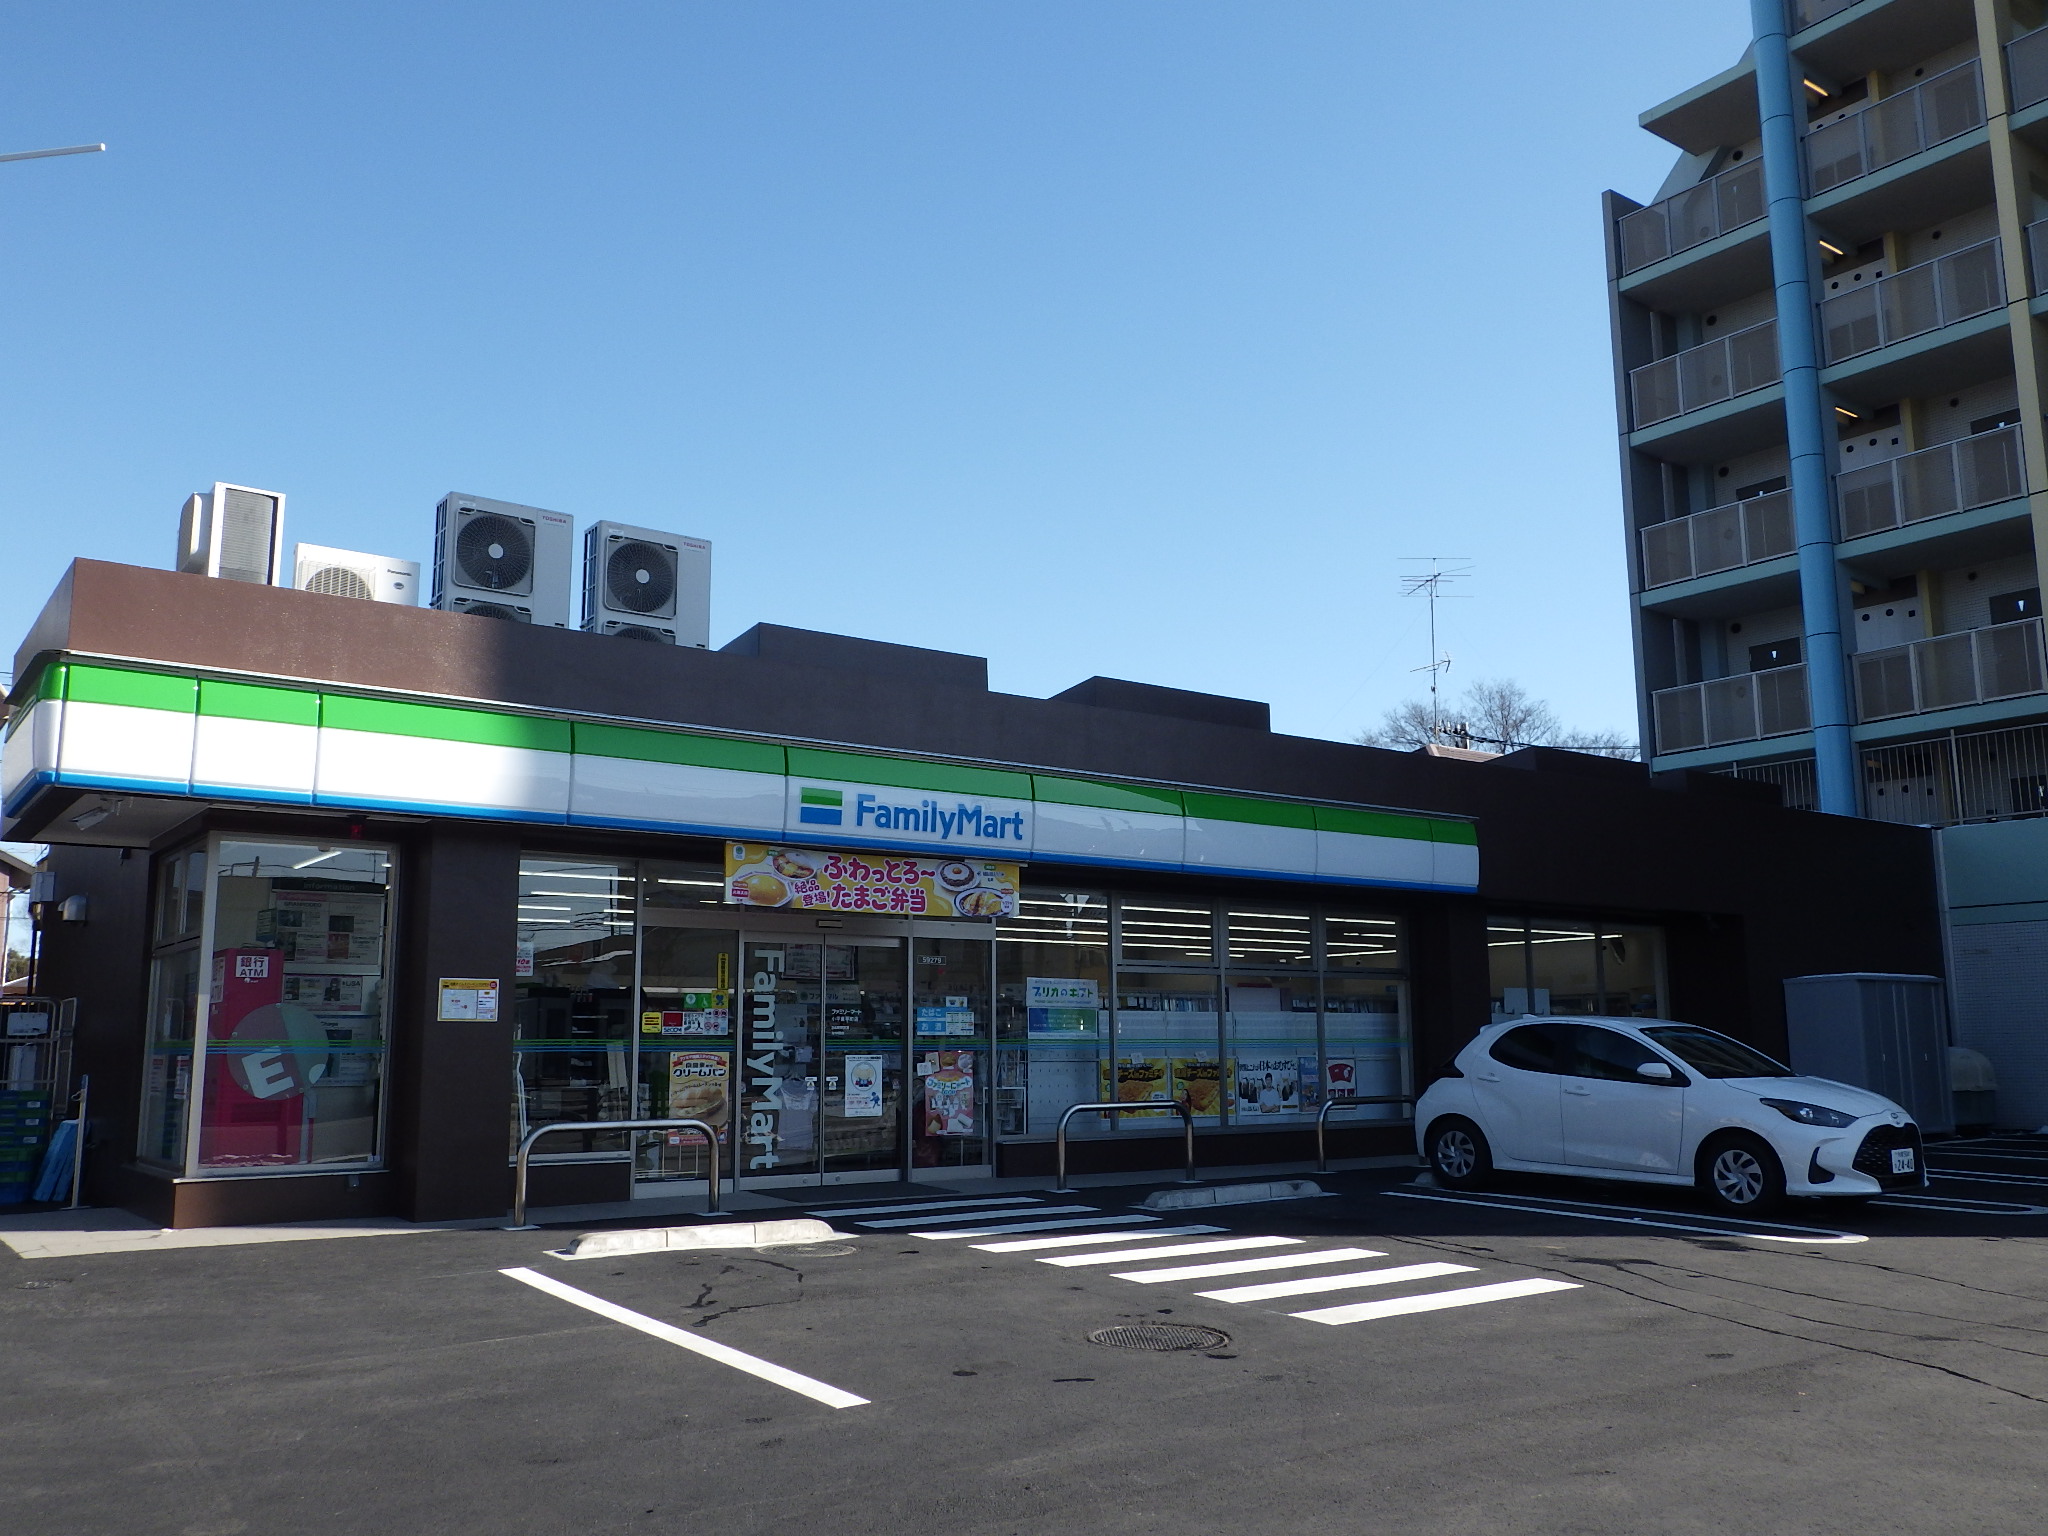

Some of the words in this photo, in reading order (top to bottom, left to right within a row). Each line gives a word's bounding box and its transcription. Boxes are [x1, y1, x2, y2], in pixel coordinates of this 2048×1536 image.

[543, 516, 567, 524] TOSHIBA
[857, 793, 1023, 840] FamilyMart
[795, 879, 820, 895] 絶品
[832, 883, 926, 913] たまご弁当
[240, 957, 265, 967] 銀行
[240, 969, 264, 977] ATM
[921, 1008, 942, 1017] たばこ
[921, 1022, 942, 1031] お酒
[747, 949, 784, 1170] FamilyMart
[673, 1068, 726, 1077] クリームパン
